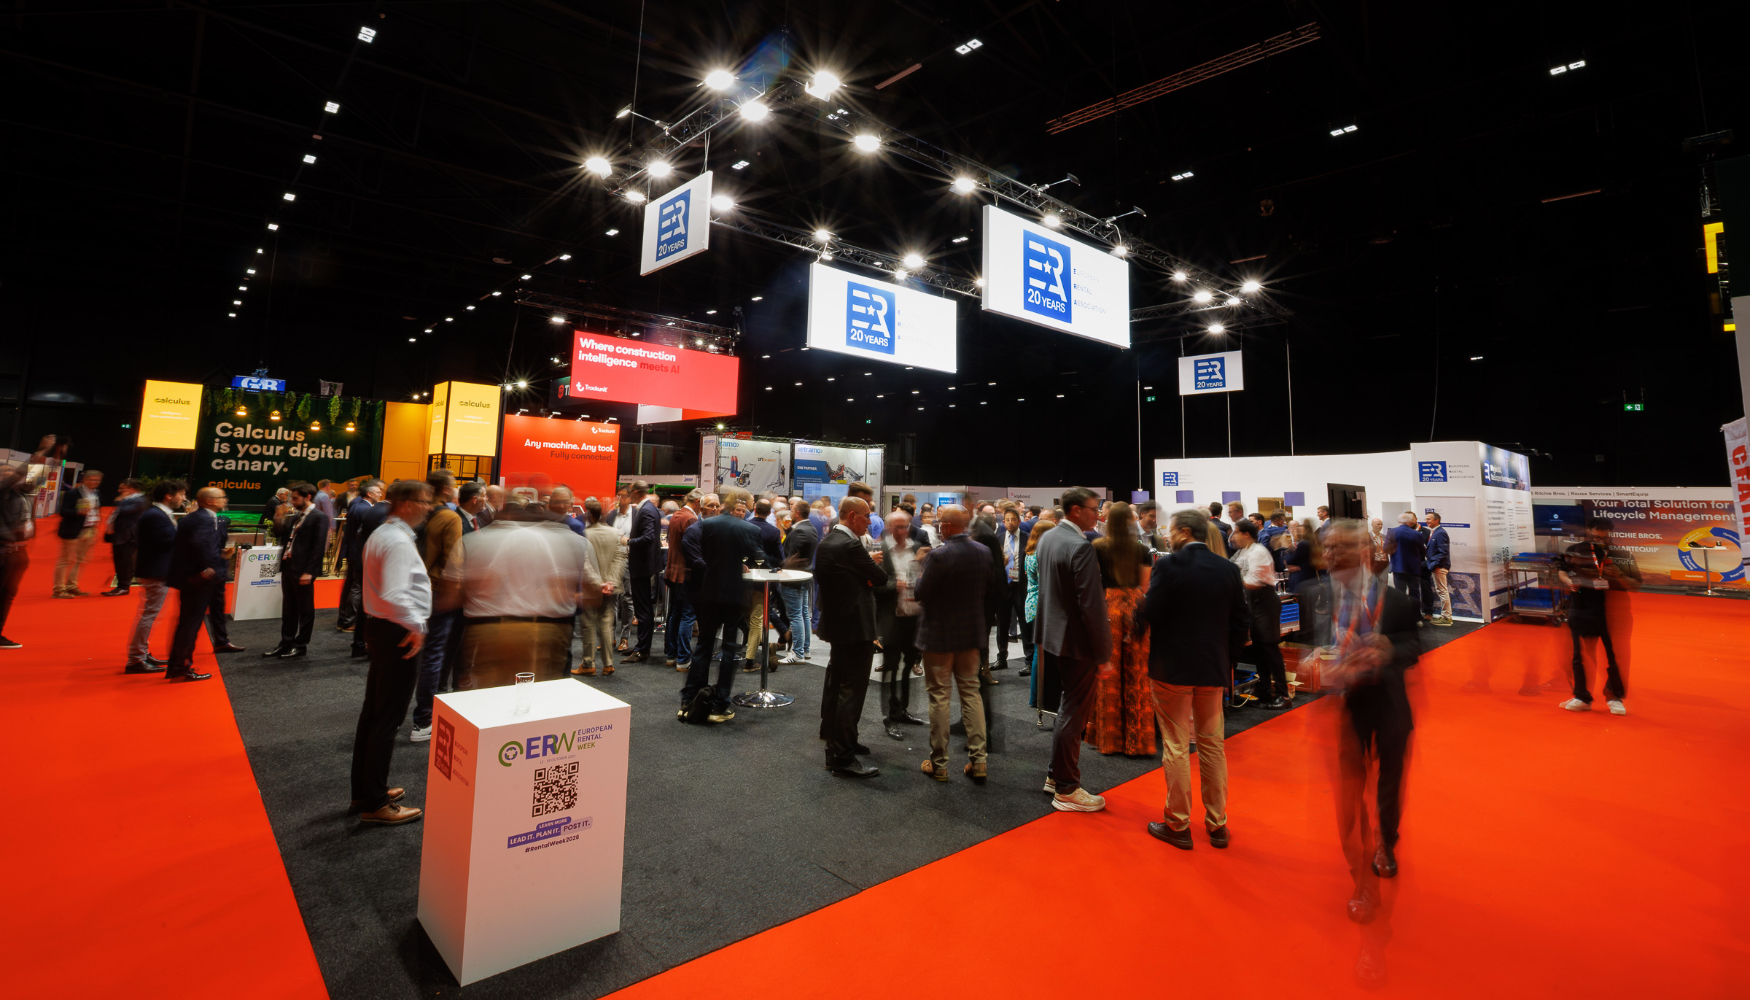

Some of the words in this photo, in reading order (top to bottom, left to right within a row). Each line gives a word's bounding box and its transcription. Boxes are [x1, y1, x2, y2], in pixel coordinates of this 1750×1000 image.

[658, 244, 667, 256] 20
[667, 239, 684, 253] YEARS
[1028, 288, 1041, 305] 20
[1042, 296, 1066, 313] YEARS
[850, 328, 863, 342] 20
[864, 334, 888, 347] YEARS
[580, 338, 614, 352] Where
[616, 346, 676, 362] construction
[578, 350, 637, 367] intelligence
[640, 362, 669, 373] meets
[670, 364, 680, 374] AI
[459, 400, 490, 408] calculus
[216, 422, 305, 441] Calculus
[213, 438, 230, 453] is
[236, 443, 284, 457] your
[289, 443, 350, 461] digital
[524, 439, 541, 449] Any
[543, 442, 580, 450] machine.
[581, 443, 596, 452] Any
[550, 451, 569, 460] Fully
[571, 453, 613, 461] connected.
[211, 459, 288, 475] canary.
[208, 479, 261, 489] calculus
[1592, 500, 1618, 508] Your
[1621, 500, 1650, 508] Total
[1654, 500, 1707, 509] Solution
[1710, 501, 1729, 509] for
[1593, 510, 1646, 520] Lifecycle
[1650, 511, 1736, 522] Management
[578, 724, 612, 735] EUROPEAN
[526, 730, 576, 760] ERW
[577, 734, 602, 742] RENTAL
[577, 742, 595, 750] WEEK
[510, 836, 526, 845] LEAD
[536, 830, 552, 838] PLAN
[564, 824, 581, 832] POST
[525, 834, 580, 853] #RentalWeek2026
